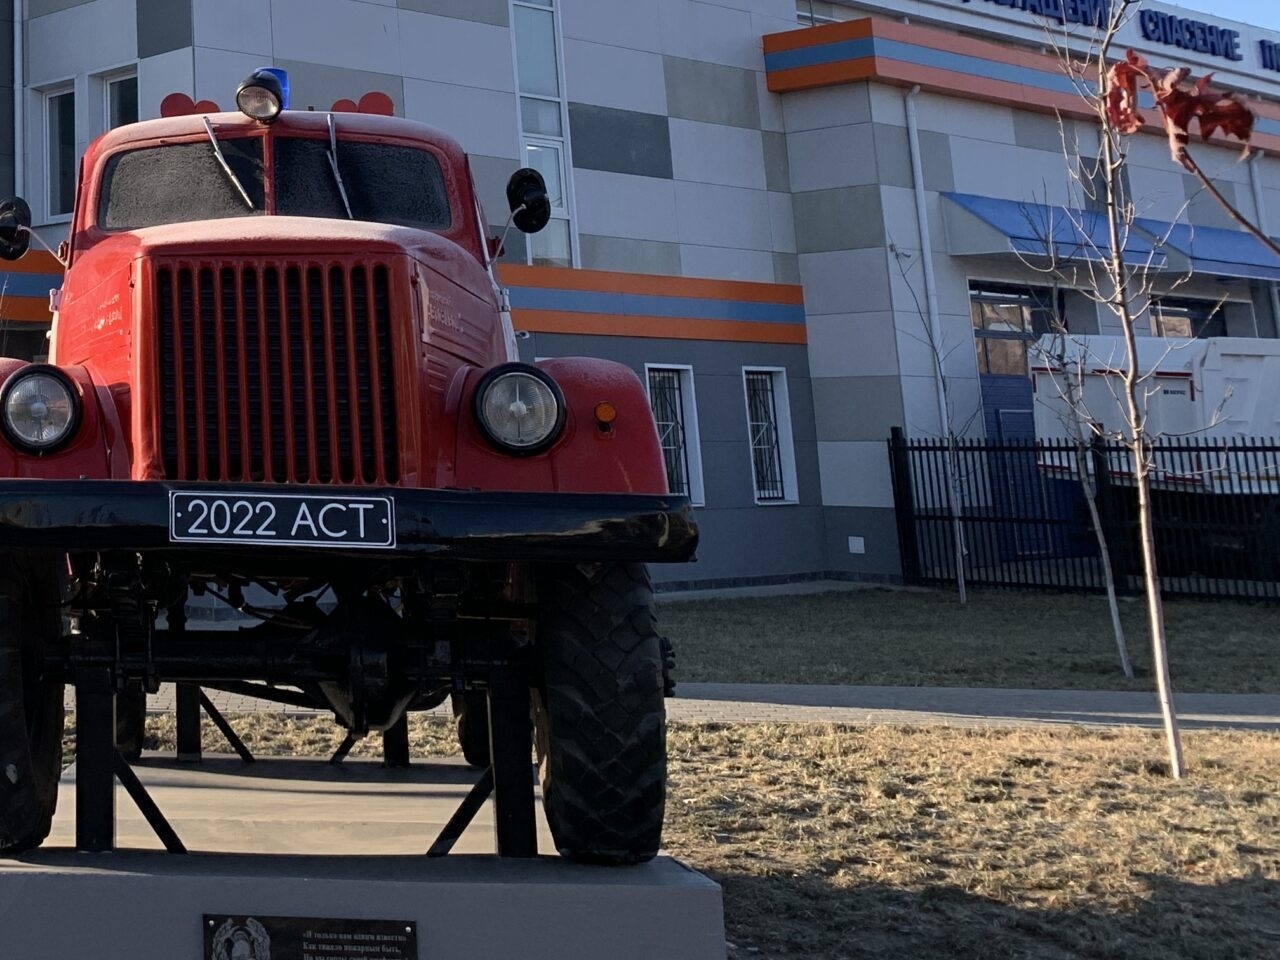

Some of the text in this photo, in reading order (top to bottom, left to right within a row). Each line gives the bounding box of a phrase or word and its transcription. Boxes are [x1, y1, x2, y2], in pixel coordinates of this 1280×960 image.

[1139, 9, 1243, 62] СПАСЕНИЕ
[187, 499, 375, 539] 2022 АСТ
